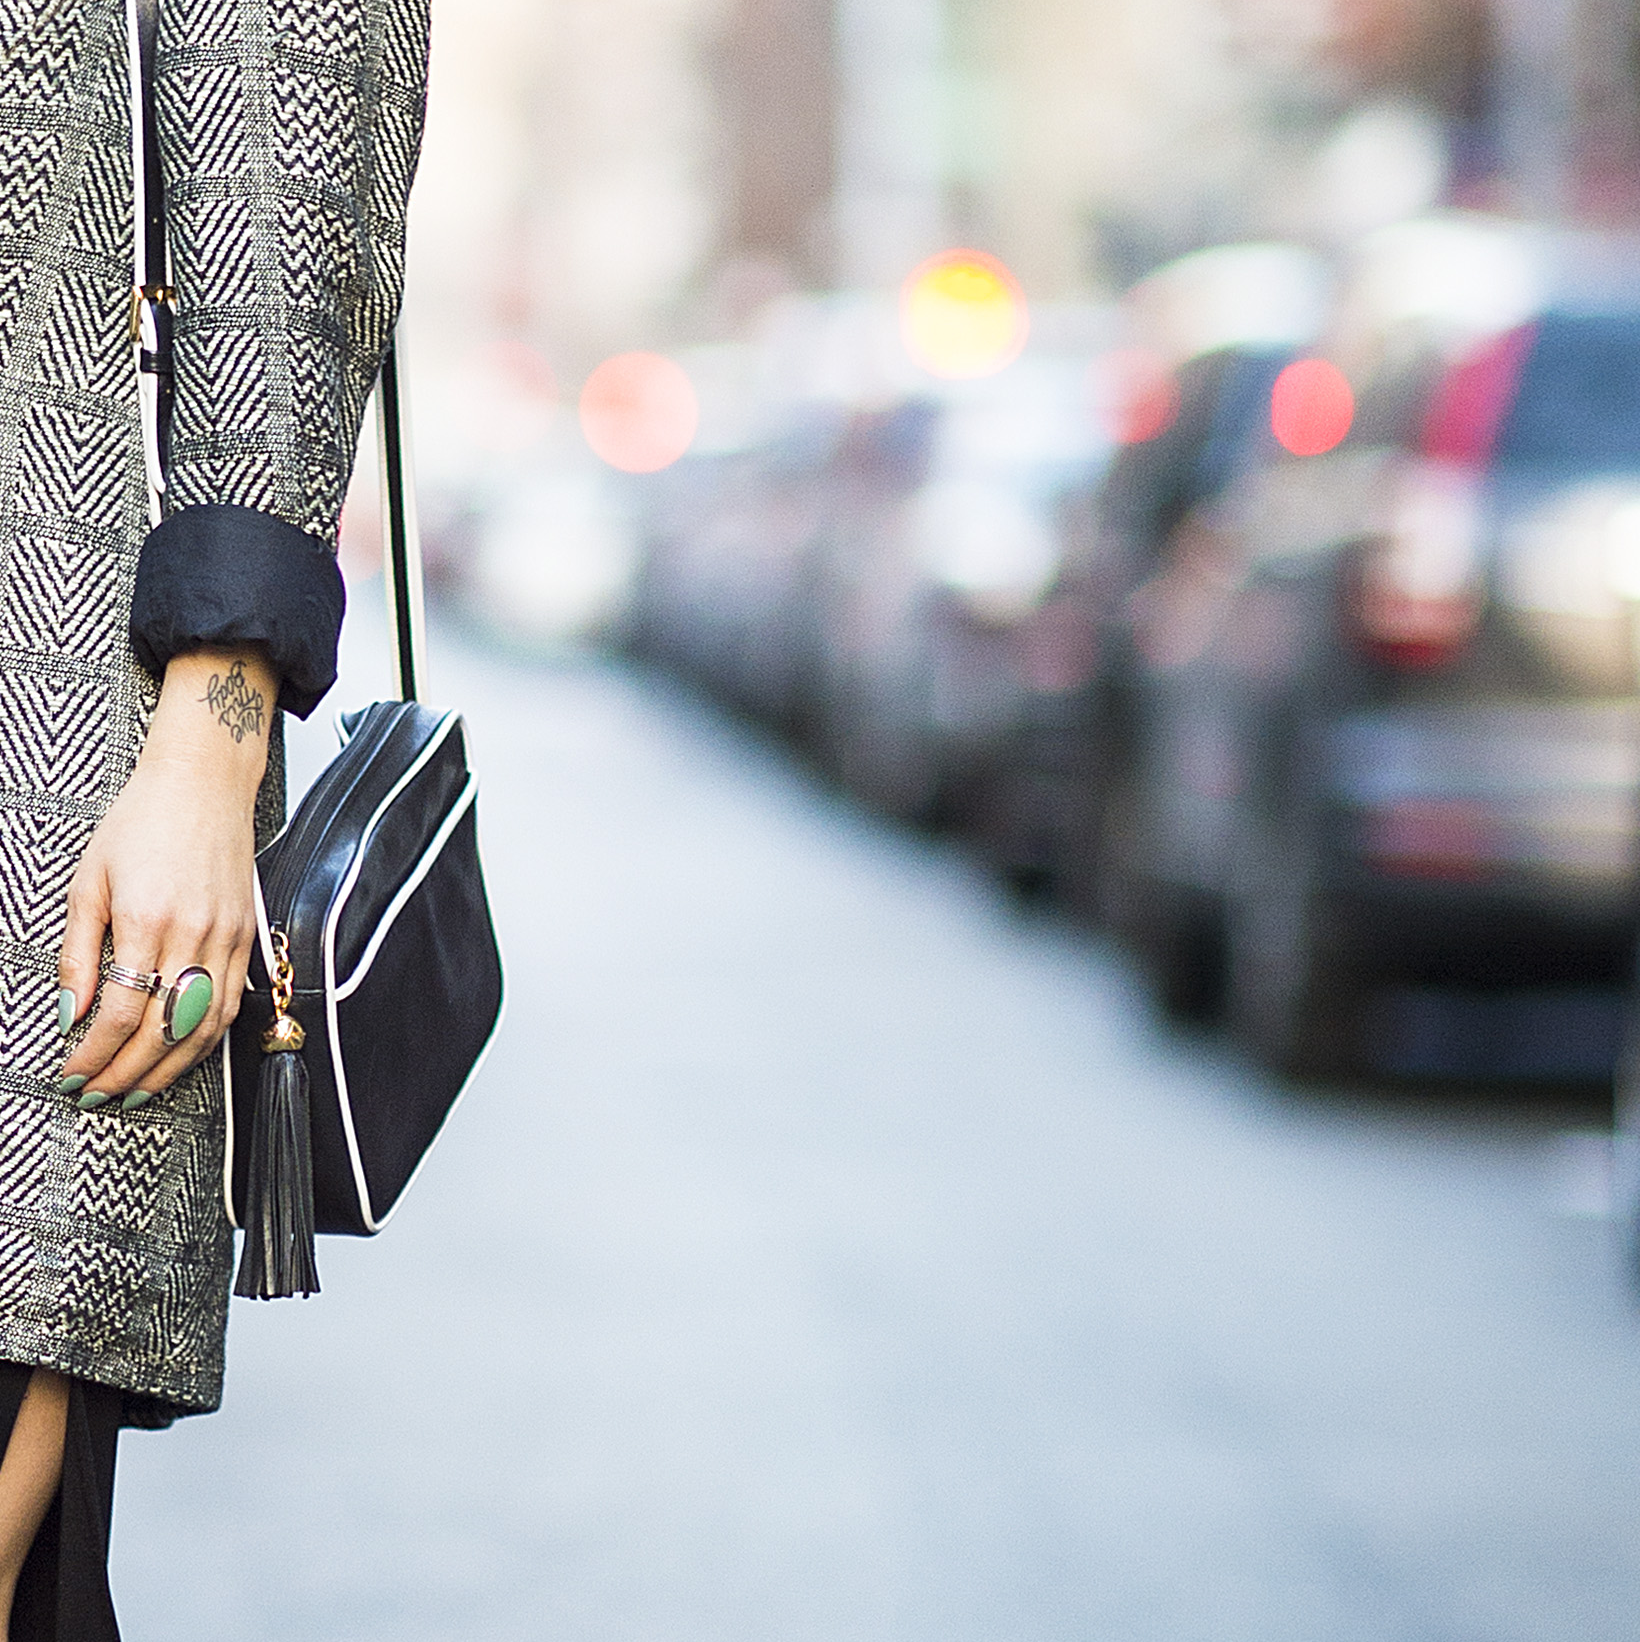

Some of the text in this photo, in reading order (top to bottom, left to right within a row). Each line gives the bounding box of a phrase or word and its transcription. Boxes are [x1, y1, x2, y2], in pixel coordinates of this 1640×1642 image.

[197, 660, 247, 715] Body
[218, 685, 256, 727] This
[230, 693, 266, 744] Love
